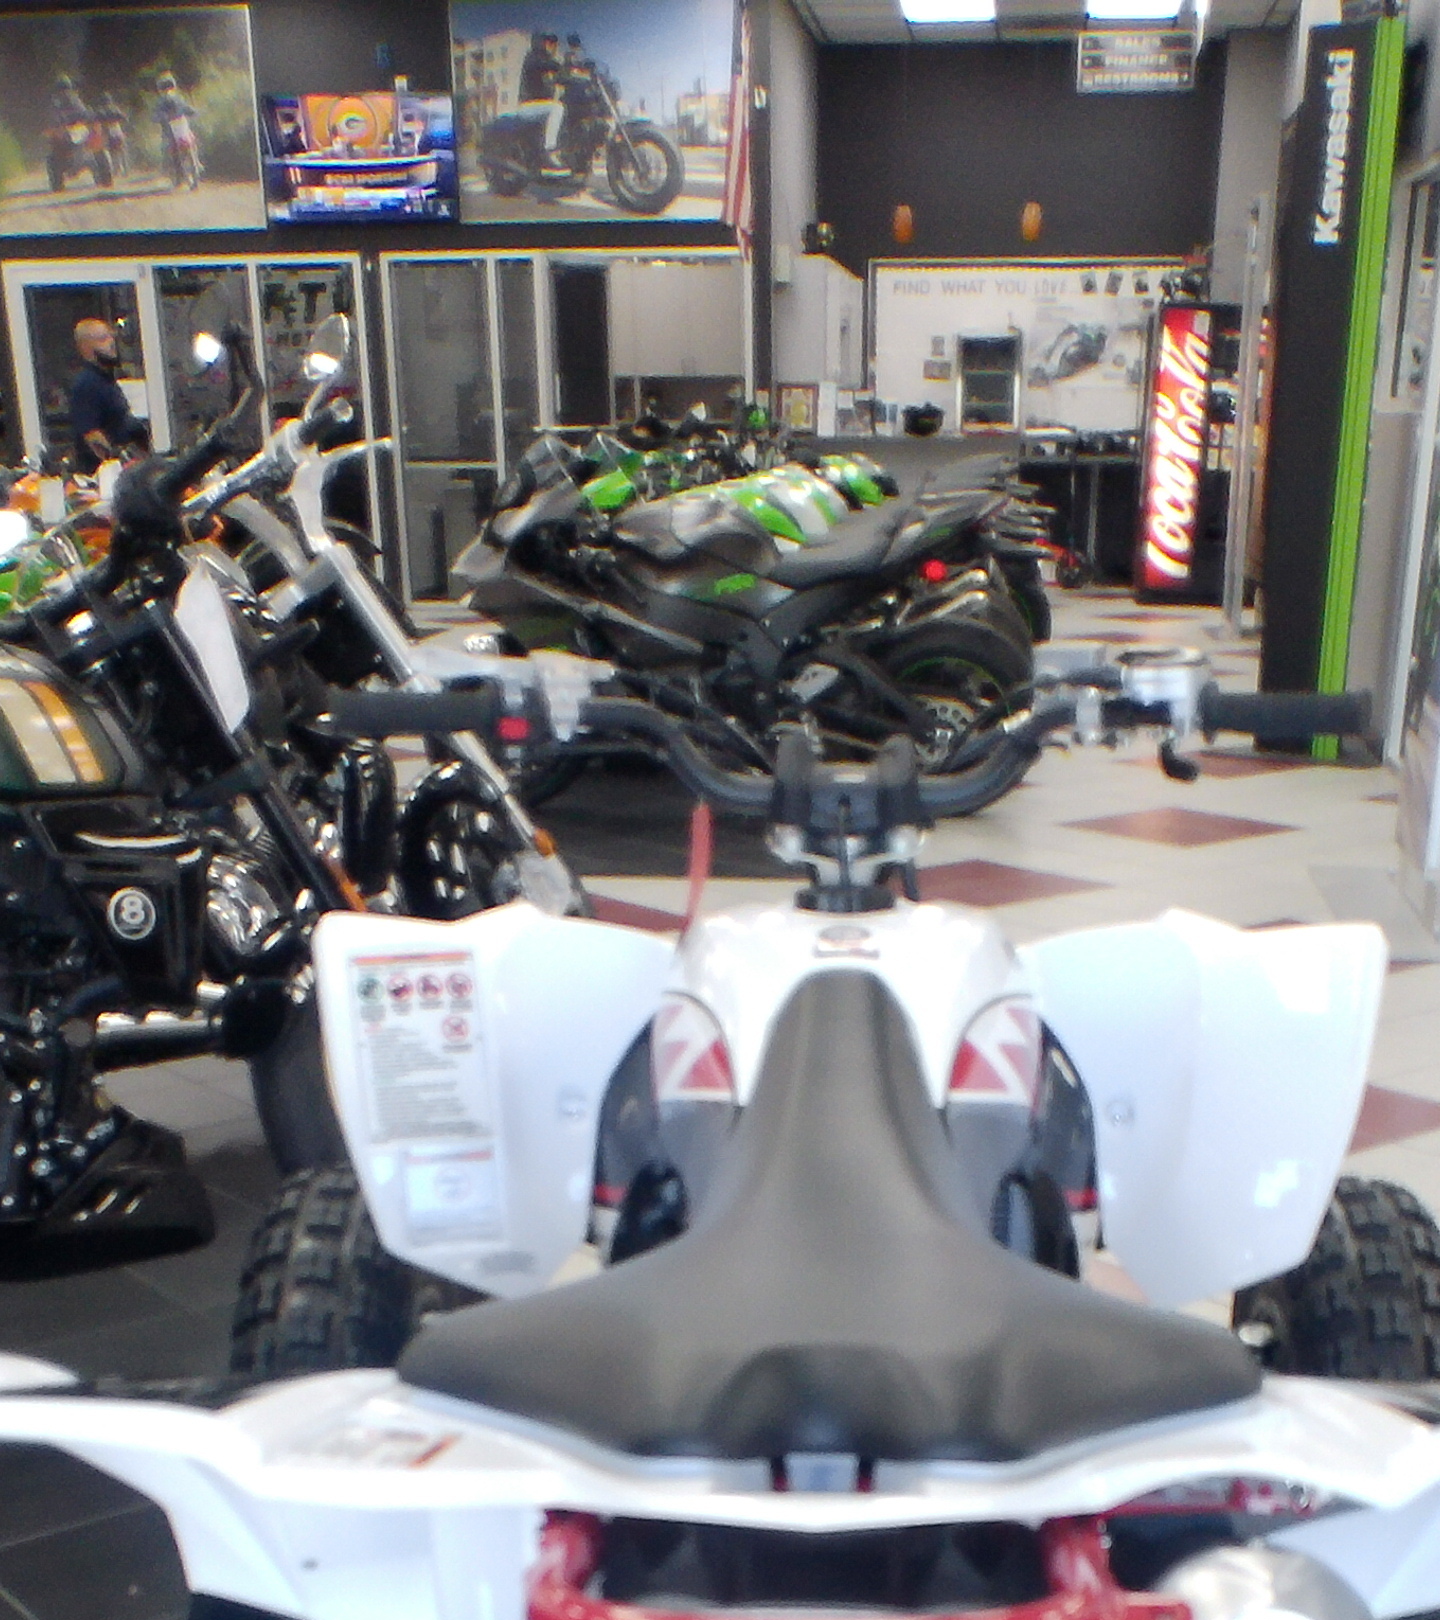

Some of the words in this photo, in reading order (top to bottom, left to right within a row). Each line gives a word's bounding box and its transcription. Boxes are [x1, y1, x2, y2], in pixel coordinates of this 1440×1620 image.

[1104, 53, 1168, 68] FINANCE
[1094, 71, 1179, 87] RESTROOMS
[1313, 49, 1354, 246] Kawasaki
[893, 279, 930, 294] FIND
[940, 279, 986, 294] WHAT
[994, 279, 1027, 294] YOU
[1144, 322, 1210, 580] Coca-Cola
